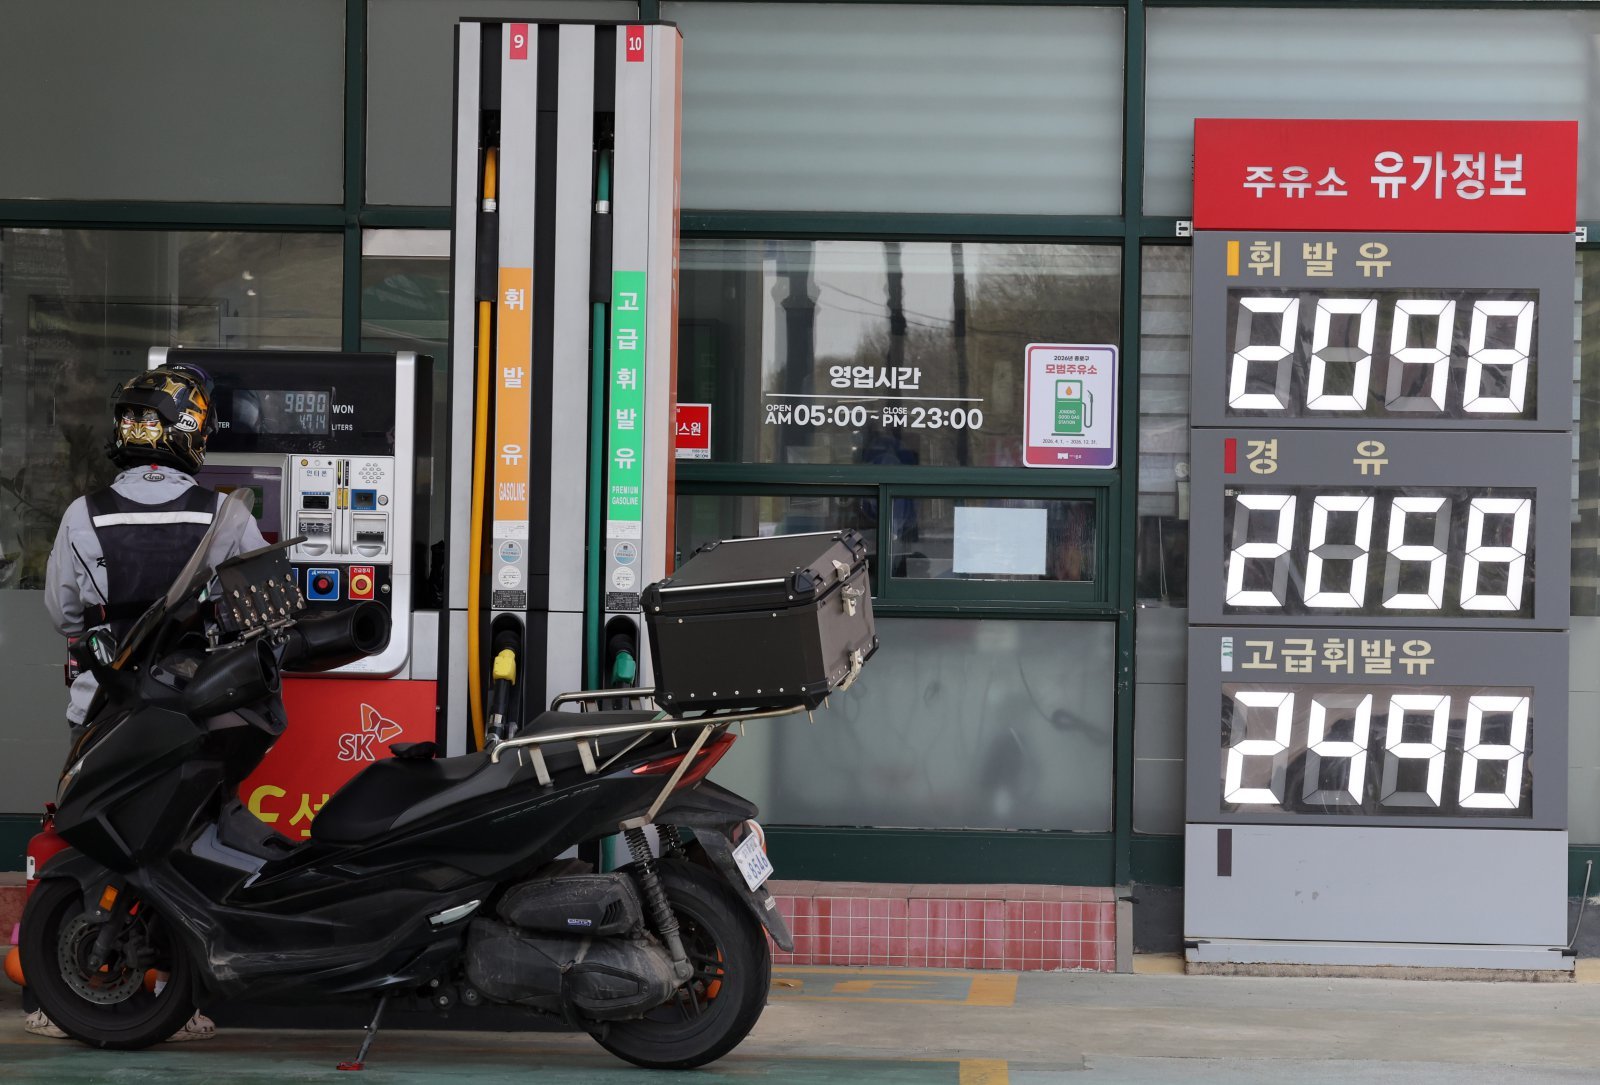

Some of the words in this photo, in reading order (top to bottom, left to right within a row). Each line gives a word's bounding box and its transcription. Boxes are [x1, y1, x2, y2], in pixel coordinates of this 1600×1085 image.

[514, 35, 524, 48] 9
[628, 36, 642, 51] 10
[1243, 165, 1348, 199] 주유소
[1370, 150, 1527, 200] 유가정보
[1228, 296, 1535, 413] 2098
[501, 288, 525, 467] 휘발유
[829, 365, 921, 390] 영업시간
[1045, 363, 1098, 375] 모범주유소
[613, 292, 639, 470] 고급휘발유
[284, 393, 327, 413] 9890
[332, 404, 354, 414] WON
[766, 404, 791, 412] OPEN
[883, 406, 907, 414] CLOSE
[178, 414, 196, 428] Arai
[217, 421, 230, 429] TER
[765, 412, 791, 425] AM
[794, 404, 867, 427] 05:00
[882, 414, 907, 428] PM
[911, 407, 983, 430] 23:00
[498, 482, 526, 501] GASOLINE
[611, 485, 639, 494] PREMIUM
[611, 496, 639, 505] GASOLINE
[1225, 494, 1532, 611] 2058
[1241, 638, 1435, 676] 고급휘발유
[337, 733, 376, 761] SK
[1223, 690, 1530, 810] 2498
